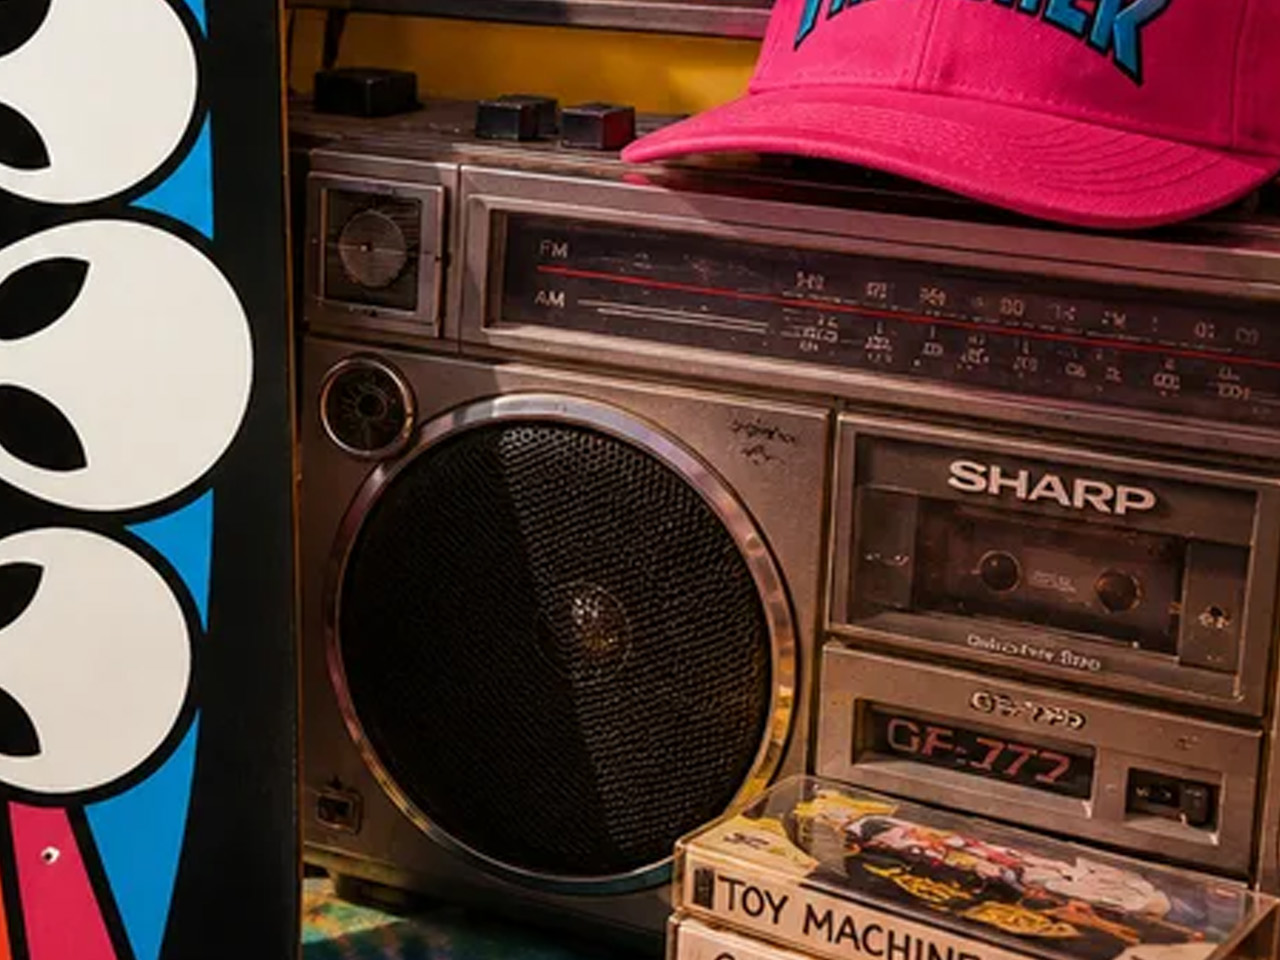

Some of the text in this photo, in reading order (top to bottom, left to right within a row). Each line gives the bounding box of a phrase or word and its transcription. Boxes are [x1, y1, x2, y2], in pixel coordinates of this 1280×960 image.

[539, 240, 568, 259] FM
[534, 291, 565, 308] AM
[947, 460, 1156, 516] SHARP
[718, 875, 788, 925] TOY
